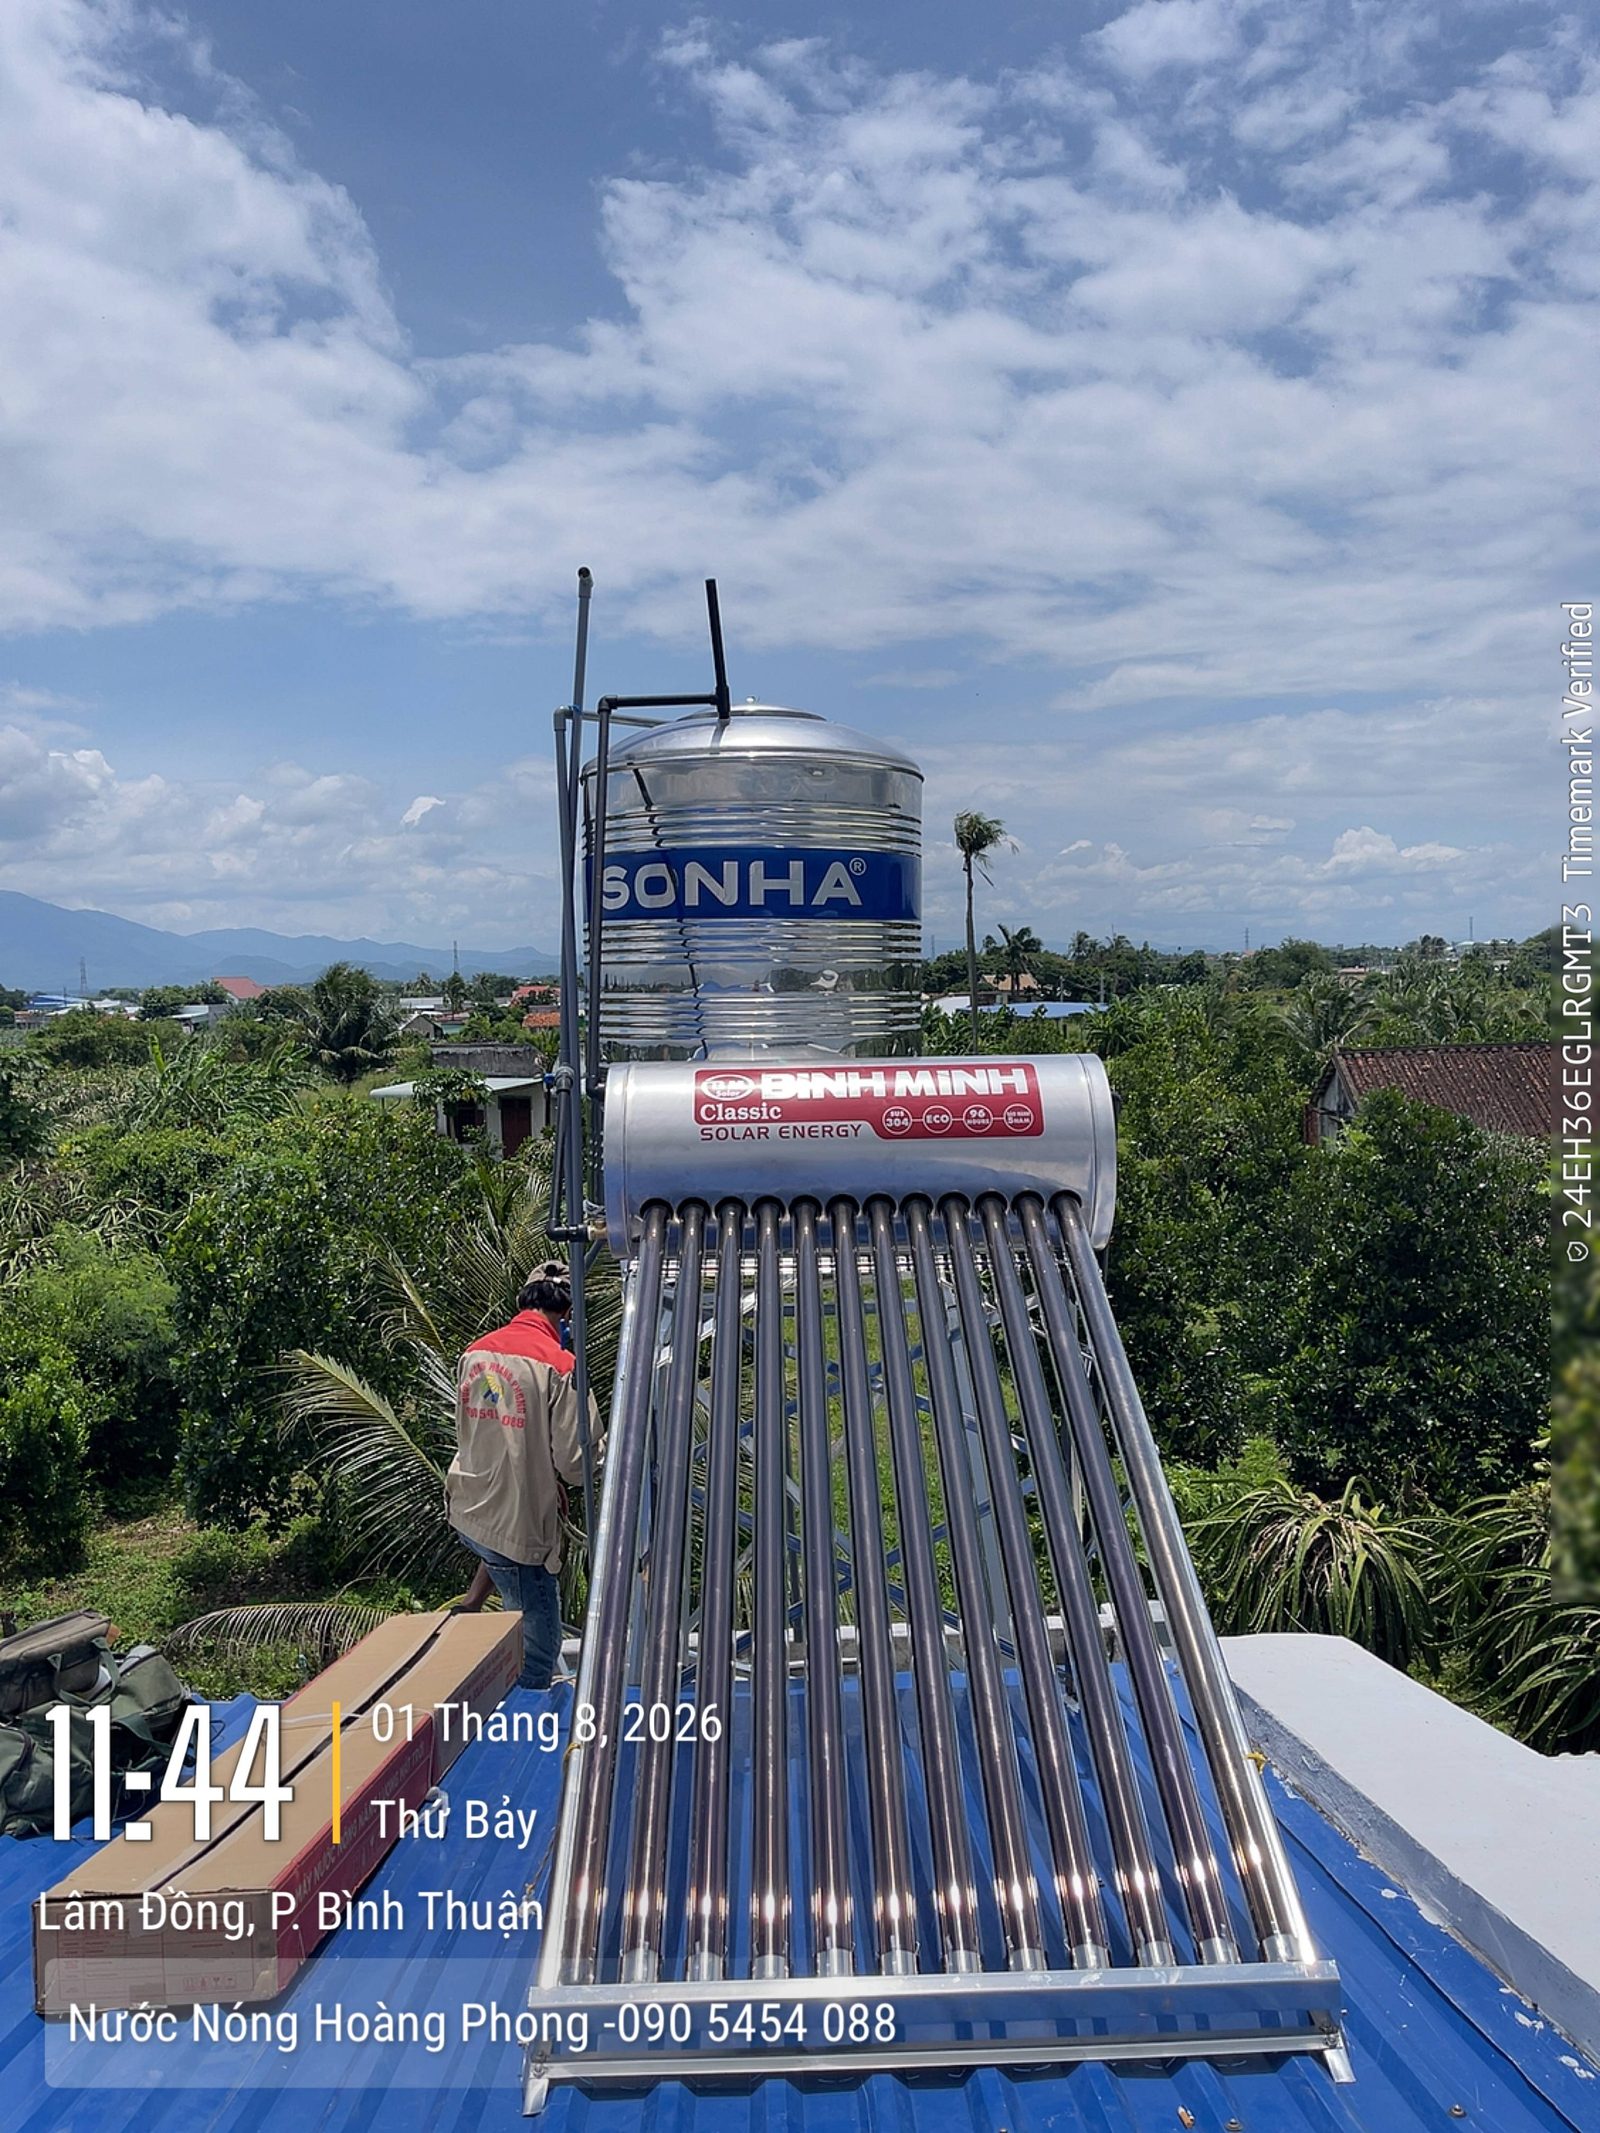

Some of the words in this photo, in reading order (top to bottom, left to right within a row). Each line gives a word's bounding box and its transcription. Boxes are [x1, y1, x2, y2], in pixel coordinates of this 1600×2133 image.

[700, 1102, 783, 1121] Classic
[969, 1109, 986, 1119] 96
[885, 1118, 909, 1128] 304
[926, 1115, 950, 1124] ECO
[701, 1125, 770, 1141] SOLAR
[779, 1124, 863, 1140] ENERGY
